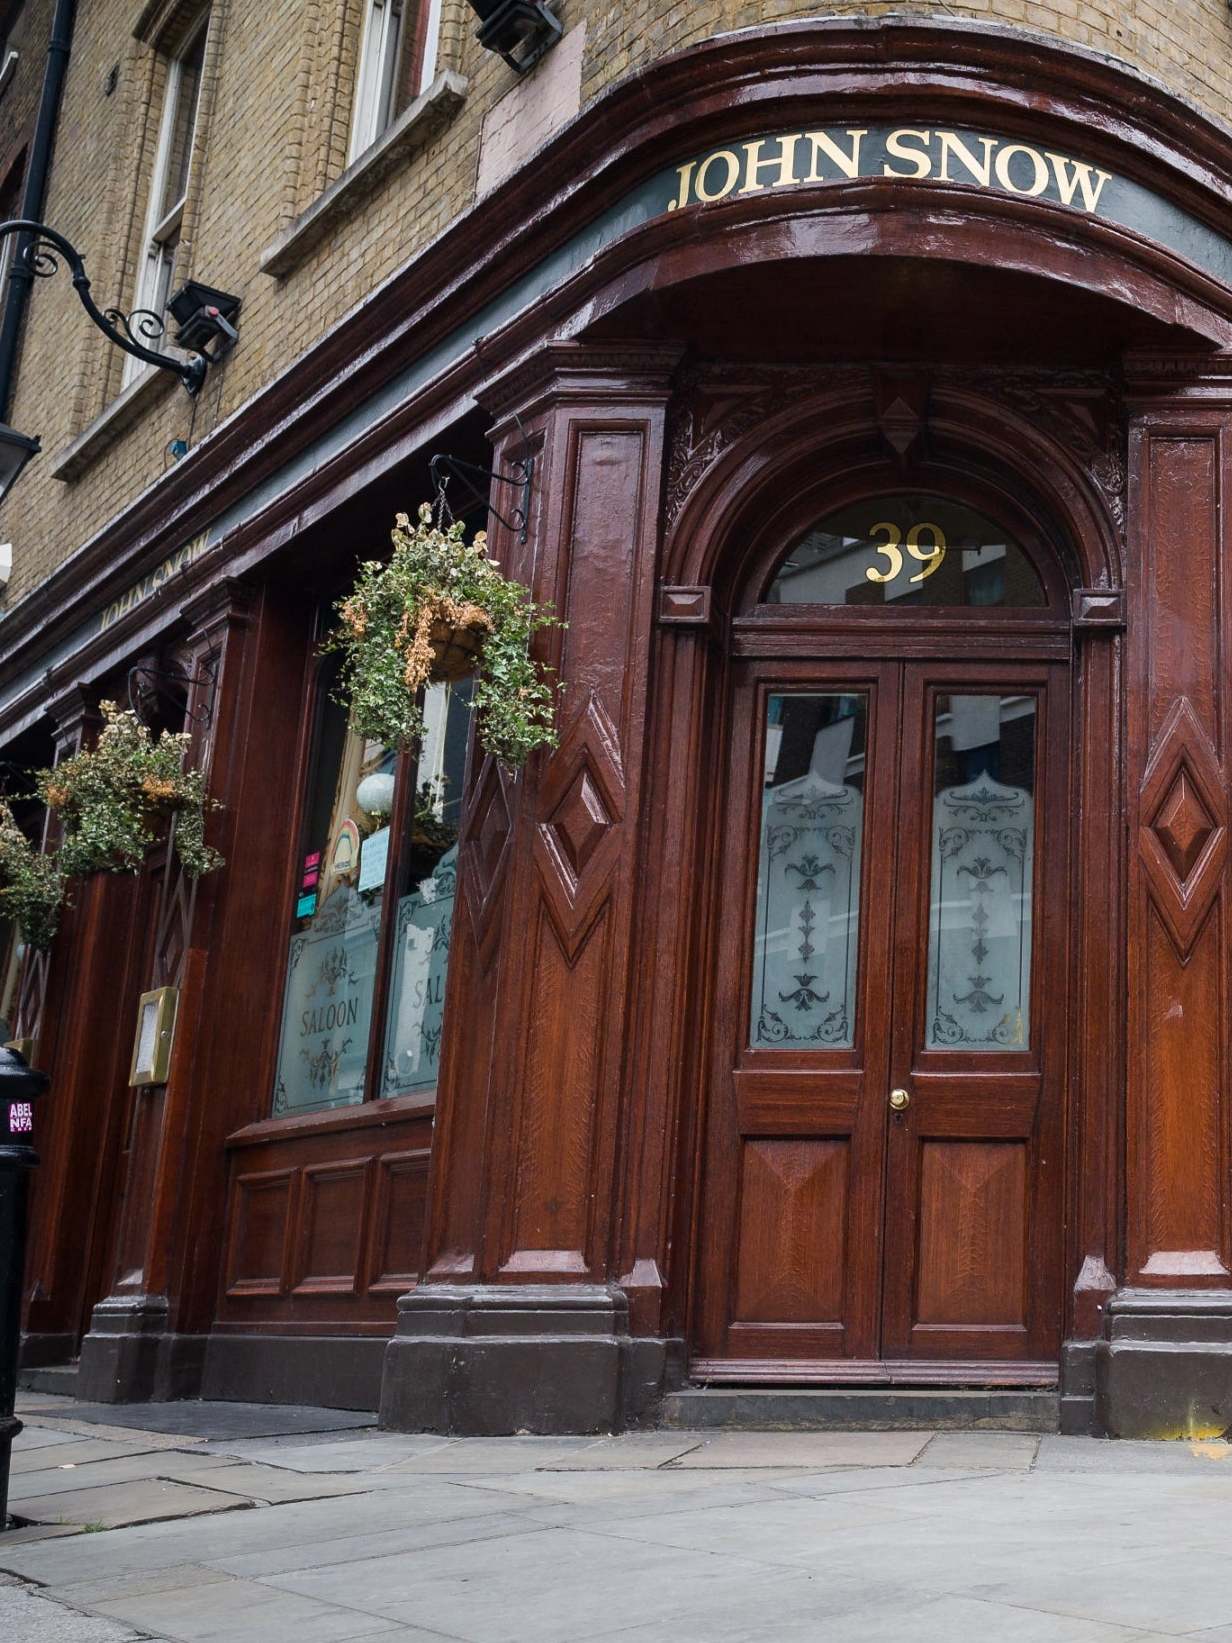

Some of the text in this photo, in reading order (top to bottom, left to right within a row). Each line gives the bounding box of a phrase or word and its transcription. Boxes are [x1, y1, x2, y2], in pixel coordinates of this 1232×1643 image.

[668, 129, 1113, 213] JOHN SNOW
[865, 522, 947, 583] 39
[101, 576, 151, 631] JOHN
[300, 997, 359, 1037] SALOON
